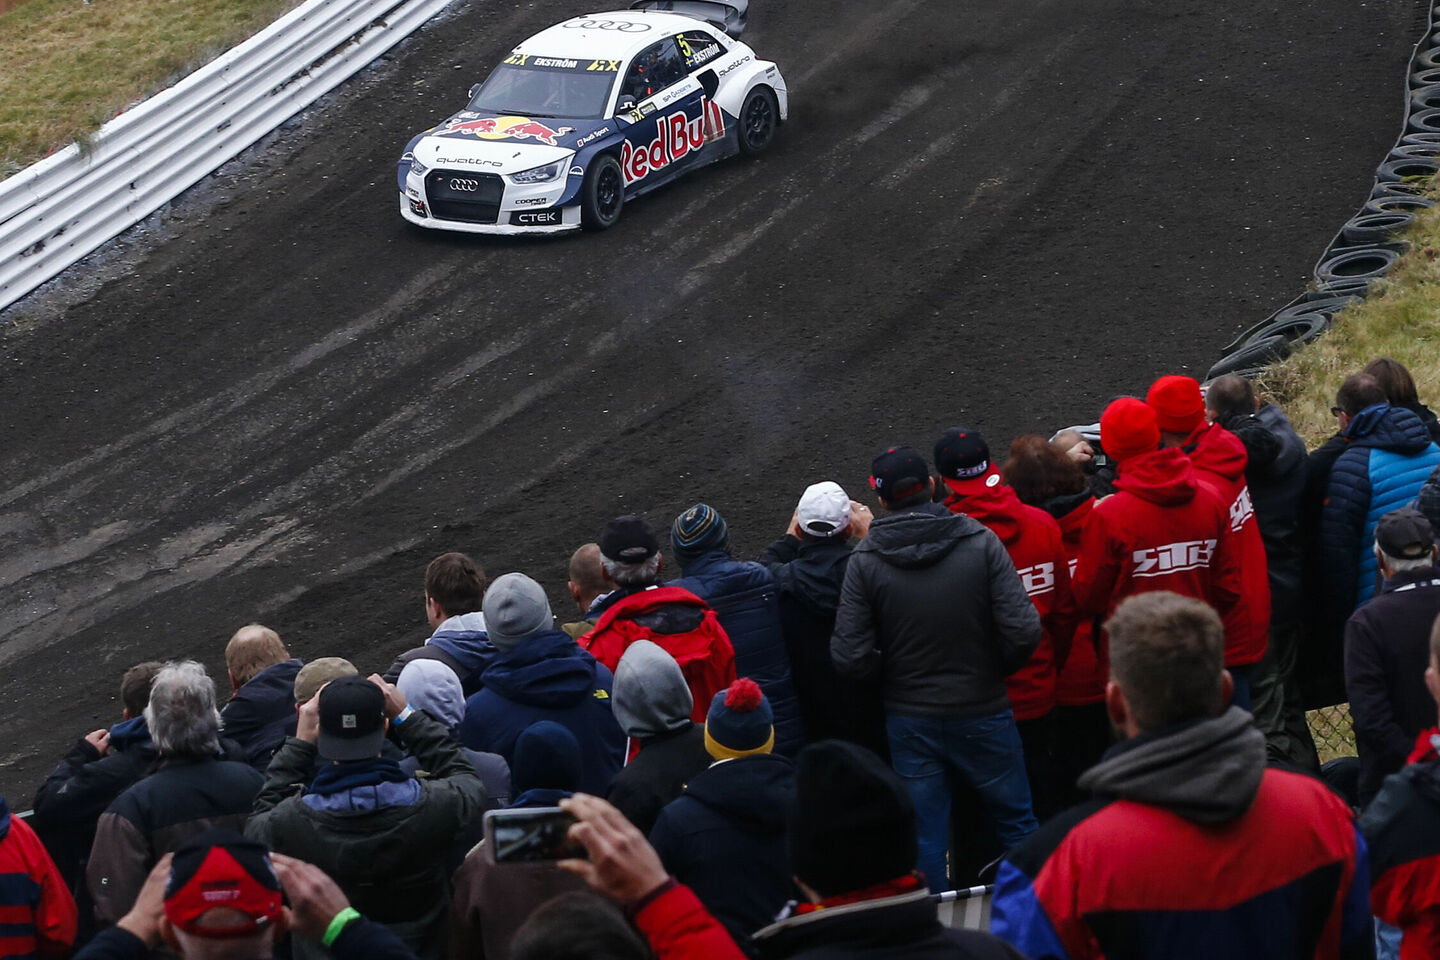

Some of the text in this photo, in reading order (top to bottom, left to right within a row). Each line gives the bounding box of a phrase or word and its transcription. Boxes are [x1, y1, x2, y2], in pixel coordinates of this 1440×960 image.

[676, 34, 691, 57] 5
[693, 43, 720, 64] EKSTRÖM
[533, 57, 578, 69] EKSTRÖM
[718, 55, 750, 76] quattro
[583, 126, 610, 144] Audi Sport
[620, 94, 726, 189] Red Bull
[436, 157, 503, 167] quattro
[515, 197, 547, 205] COOPER
[518, 212, 556, 223] CTEK
